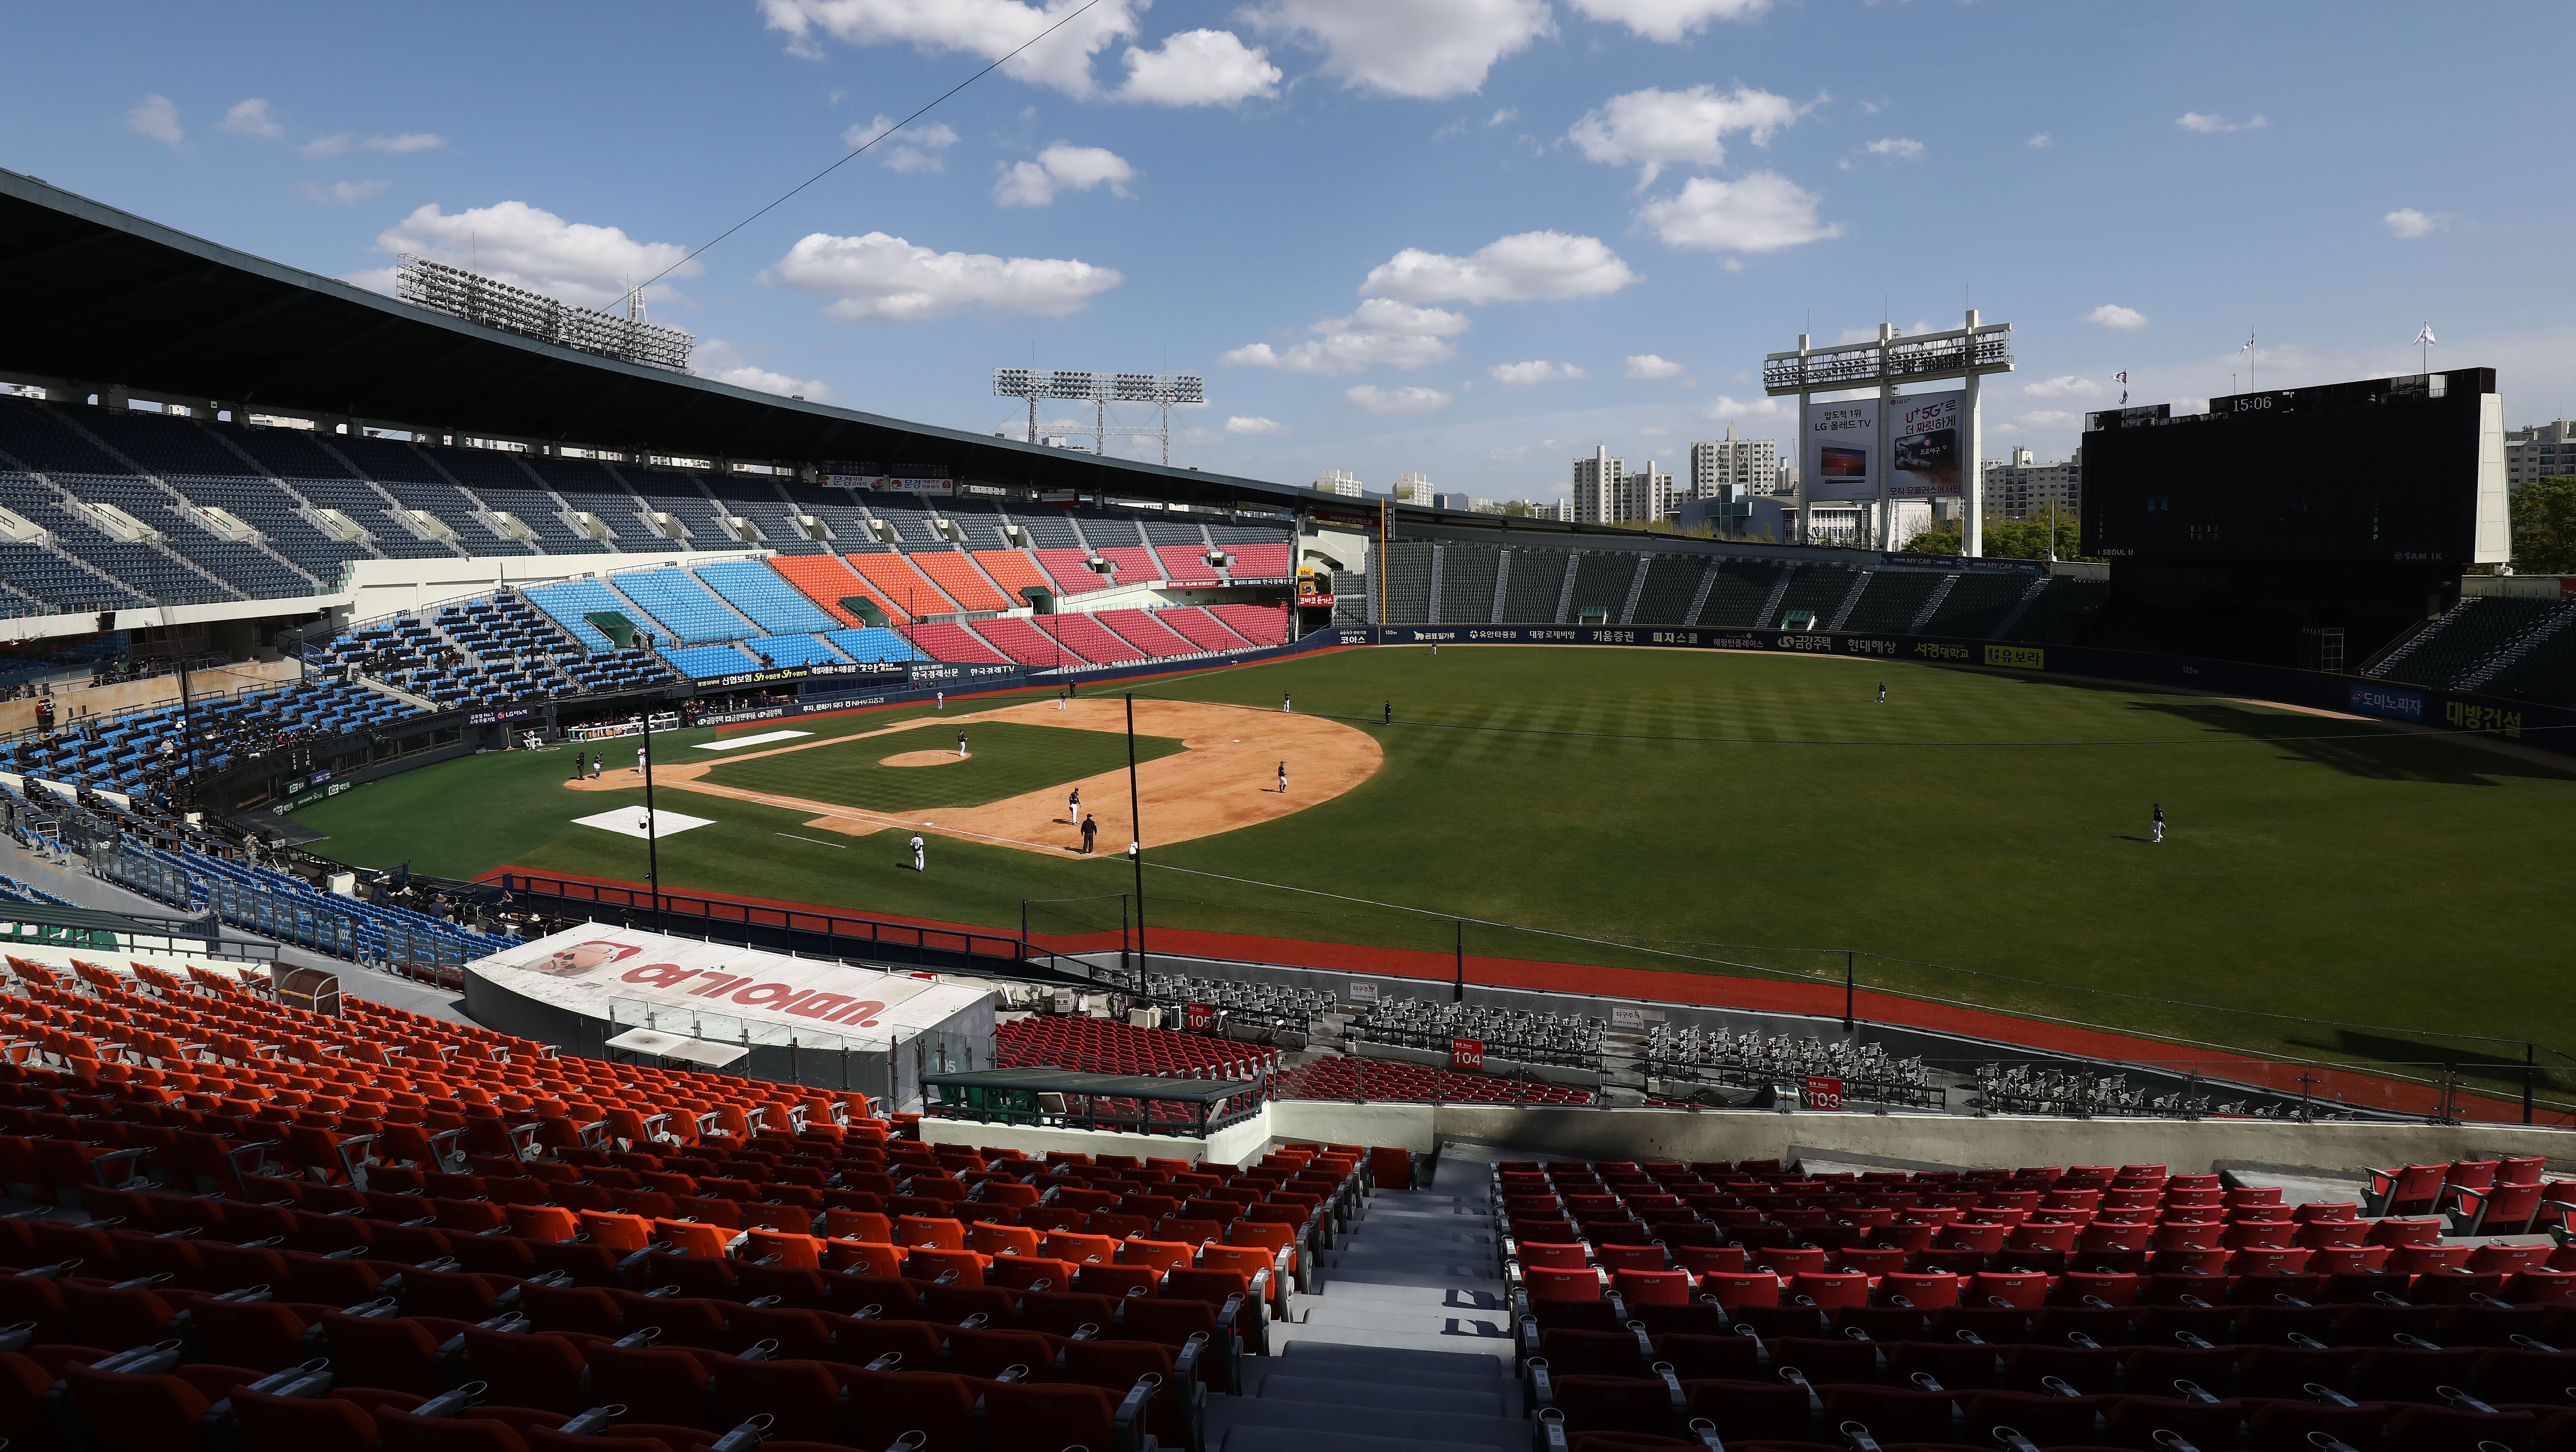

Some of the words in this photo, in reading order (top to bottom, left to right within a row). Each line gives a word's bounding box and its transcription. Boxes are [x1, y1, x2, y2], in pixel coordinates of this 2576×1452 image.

[2233, 396, 2271, 412] 15:06
[1824, 410, 1846, 420] 압도적
[1850, 409, 1861, 417] 1위
[1815, 422, 1827, 431] LG
[1830, 420, 1856, 431] 올레드
[1858, 419, 1871, 428] TV
[1906, 424, 1914, 435] 더
[1916, 415, 1955, 432] 짜릿하게
[833, 476, 851, 486] 문경
[904, 479, 921, 489] 문경
[1907, 485, 1961, 494] 유플러스에서만
[2404, 552, 2427, 560] SAM
[2432, 552, 2443, 560] IK
[1300, 596, 1316, 604] 코바코
[1317, 596, 1333, 604] 돈가스
[1530, 631, 1544, 639] 대광
[1546, 631, 1576, 639] 로제비앙
[1593, 631, 1634, 642] 키움증권
[1653, 632, 1697, 644] 피자스쿨
[1714, 639, 1763, 648] 해링턴플레이스
[1796, 635, 1831, 650] 금강주택
[1848, 639, 1896, 654] 현대해상
[1914, 642, 1969, 659] 서경대학교
[2001, 649, 2040, 665] 유보라
[859, 664, 894, 673] 장수돌침대
[912, 669, 958, 680] 한국경제신문
[721, 674, 751, 685] 신협보험
[754, 672, 765, 681] Sh
[782, 669, 792, 678] Sh
[2363, 692, 2422, 715] 도미노피자
[706, 716, 724, 724] 금강주택
[766, 708, 782, 717] 금강주택
[2446, 701, 2521, 738] 대방건설
[329, 784, 339, 796] KCC
[339, 782, 350, 790] 페인트
[283, 802, 294, 811] 페인트
[337, 929, 348, 940] 107
[1189, 1014, 1211, 1028] 105
[1455, 1051, 1481, 1066] 104
[1808, 1091, 1839, 1108] 103
